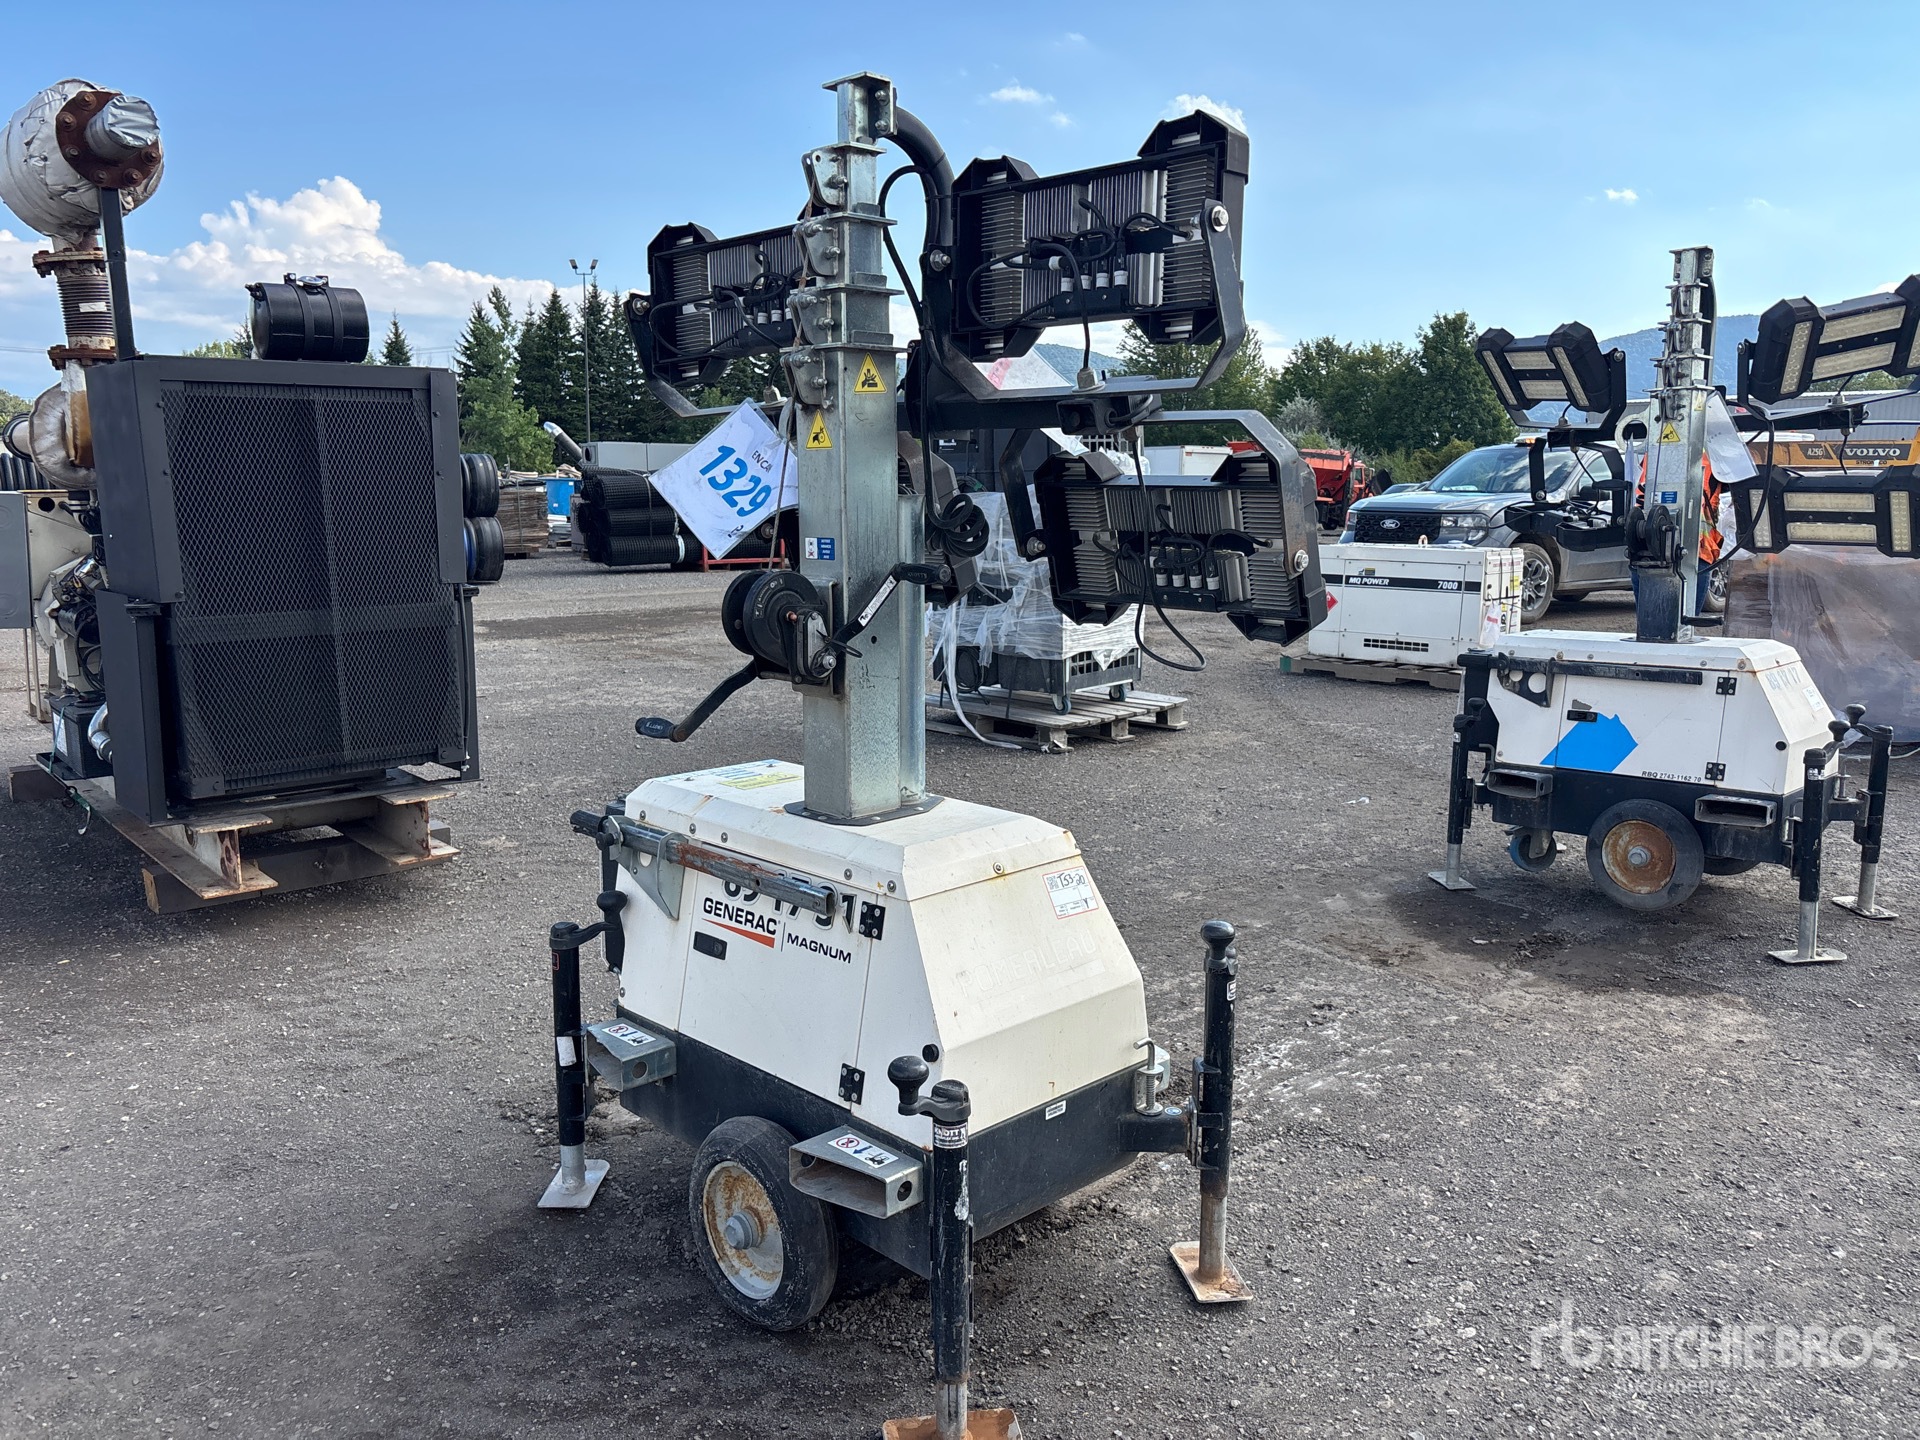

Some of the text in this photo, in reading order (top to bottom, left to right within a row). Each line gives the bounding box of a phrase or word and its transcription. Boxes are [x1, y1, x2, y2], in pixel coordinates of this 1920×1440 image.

[1844, 448, 1901, 456] VOLVO
[699, 445, 772, 517] 1329
[1362, 577, 1390, 585] POWER
[1437, 581, 1458, 590] 7000
[1641, 770, 1658, 779] RBQ
[703, 897, 777, 936] GENERAC
[787, 932, 852, 964] MAGNUM
